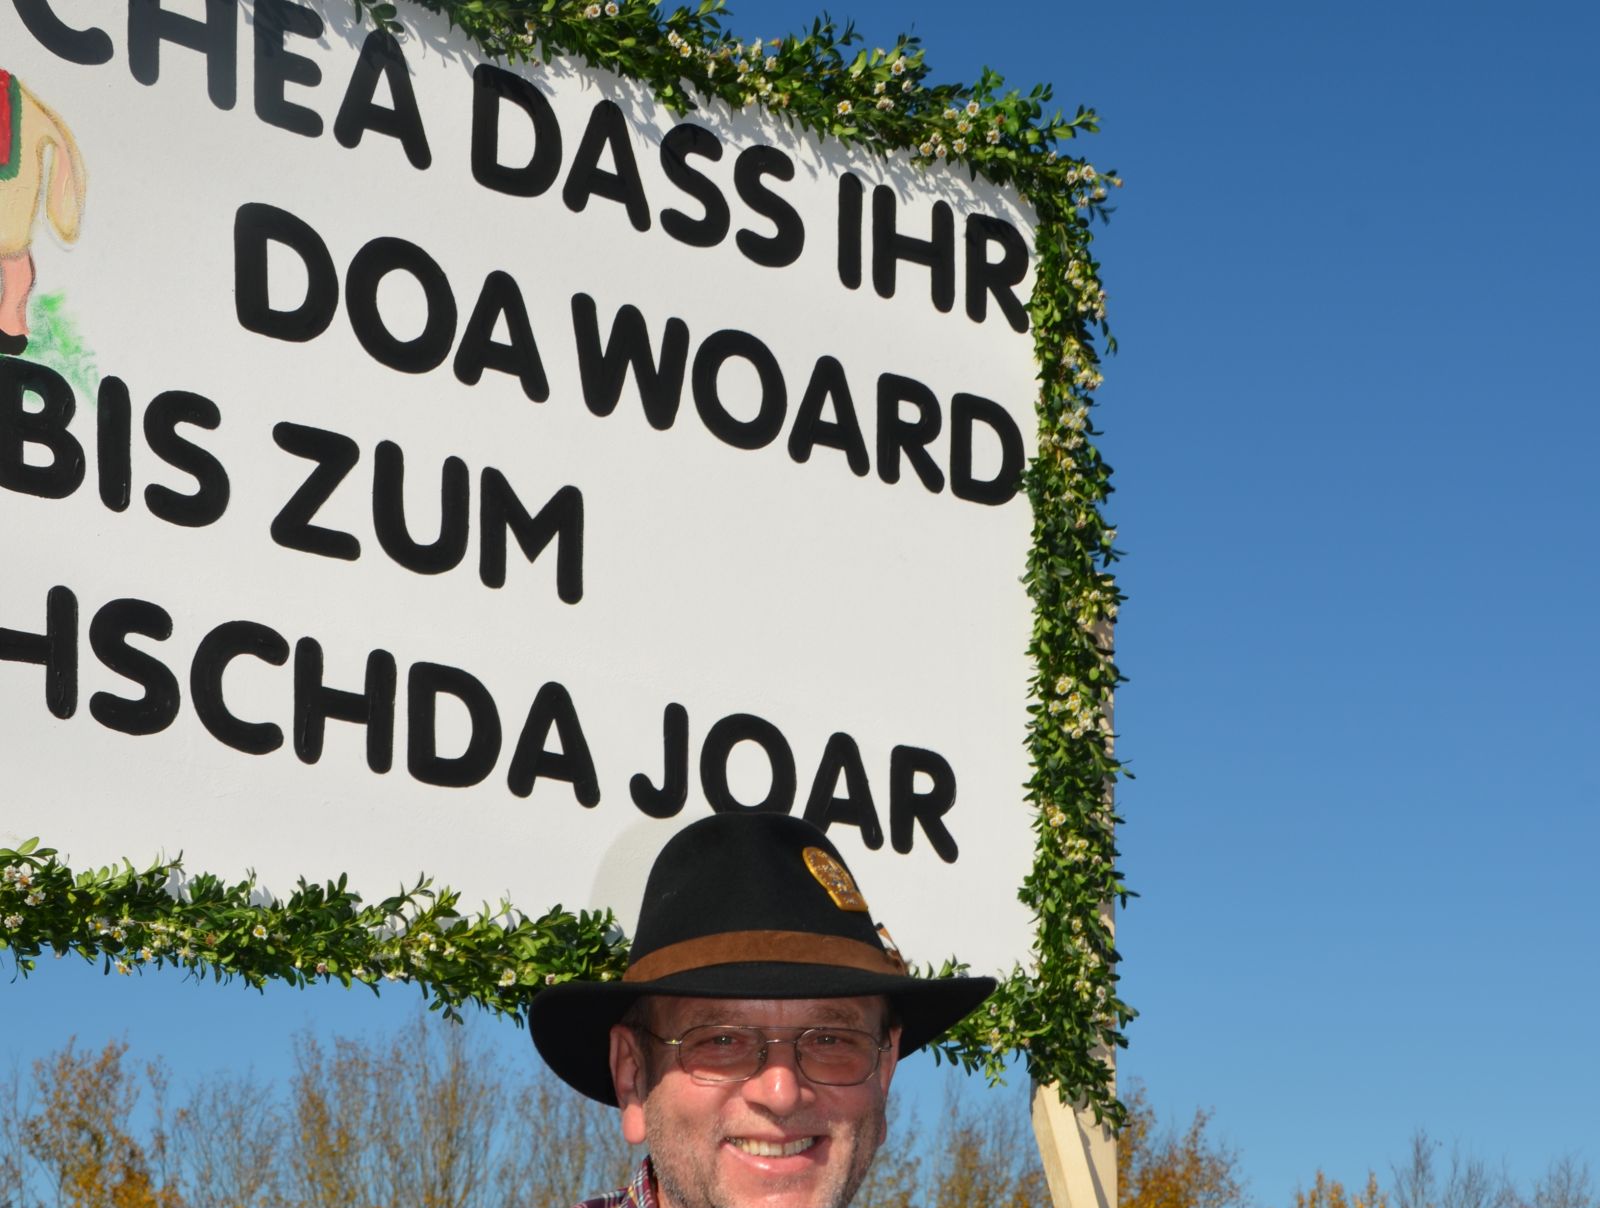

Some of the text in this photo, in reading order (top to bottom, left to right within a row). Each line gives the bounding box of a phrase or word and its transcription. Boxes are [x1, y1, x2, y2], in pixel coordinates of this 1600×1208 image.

[471, 63, 804, 268] DASS
[838, 172, 1030, 334] IHR
[0, 355, 584, 605] BIS ZUM
[234, 203, 1025, 506] DOA WOARD
[630, 702, 959, 864] JOAR
